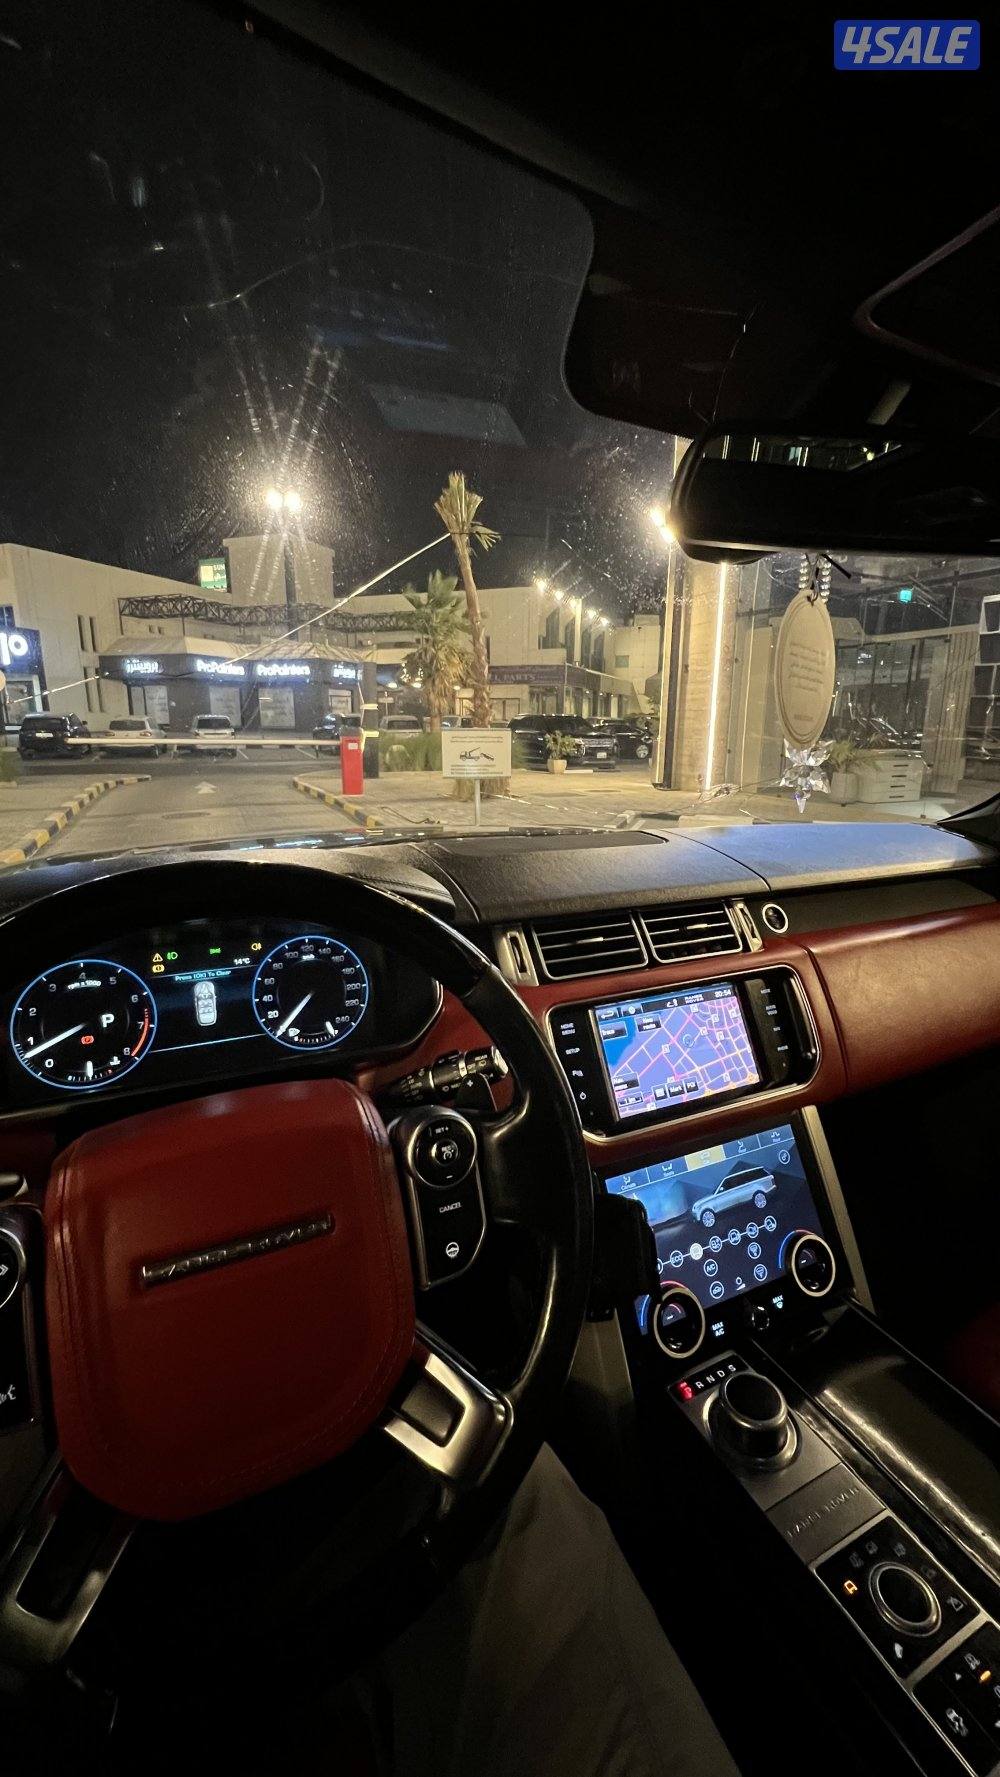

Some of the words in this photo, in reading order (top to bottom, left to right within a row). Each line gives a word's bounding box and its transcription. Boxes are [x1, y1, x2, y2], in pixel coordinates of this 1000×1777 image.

[109, 977, 117, 985] 5
[49, 984, 56, 992] 3
[346, 983, 360, 991] 200
[715, 989, 732, 998] 20:54
[131, 994, 138, 1003] 6
[345, 999, 359, 1007] 220
[29, 1007, 37, 1016] 2
[267, 1010, 279, 1019] 20
[101, 1013, 115, 1028] P
[335, 1015, 350, 1024] 240
[137, 1021, 144, 1030] 7
[27, 1036, 34, 1045] 1
[123, 1047, 130, 1055] 8
[45, 1058, 54, 1068] 0
[439, 1202, 462, 1213] CANCEL
[695, 1381, 704, 1389] R
[706, 1374, 715, 1383] N
[717, 1370, 725, 1378] D
[728, 1364, 736, 1372] S
